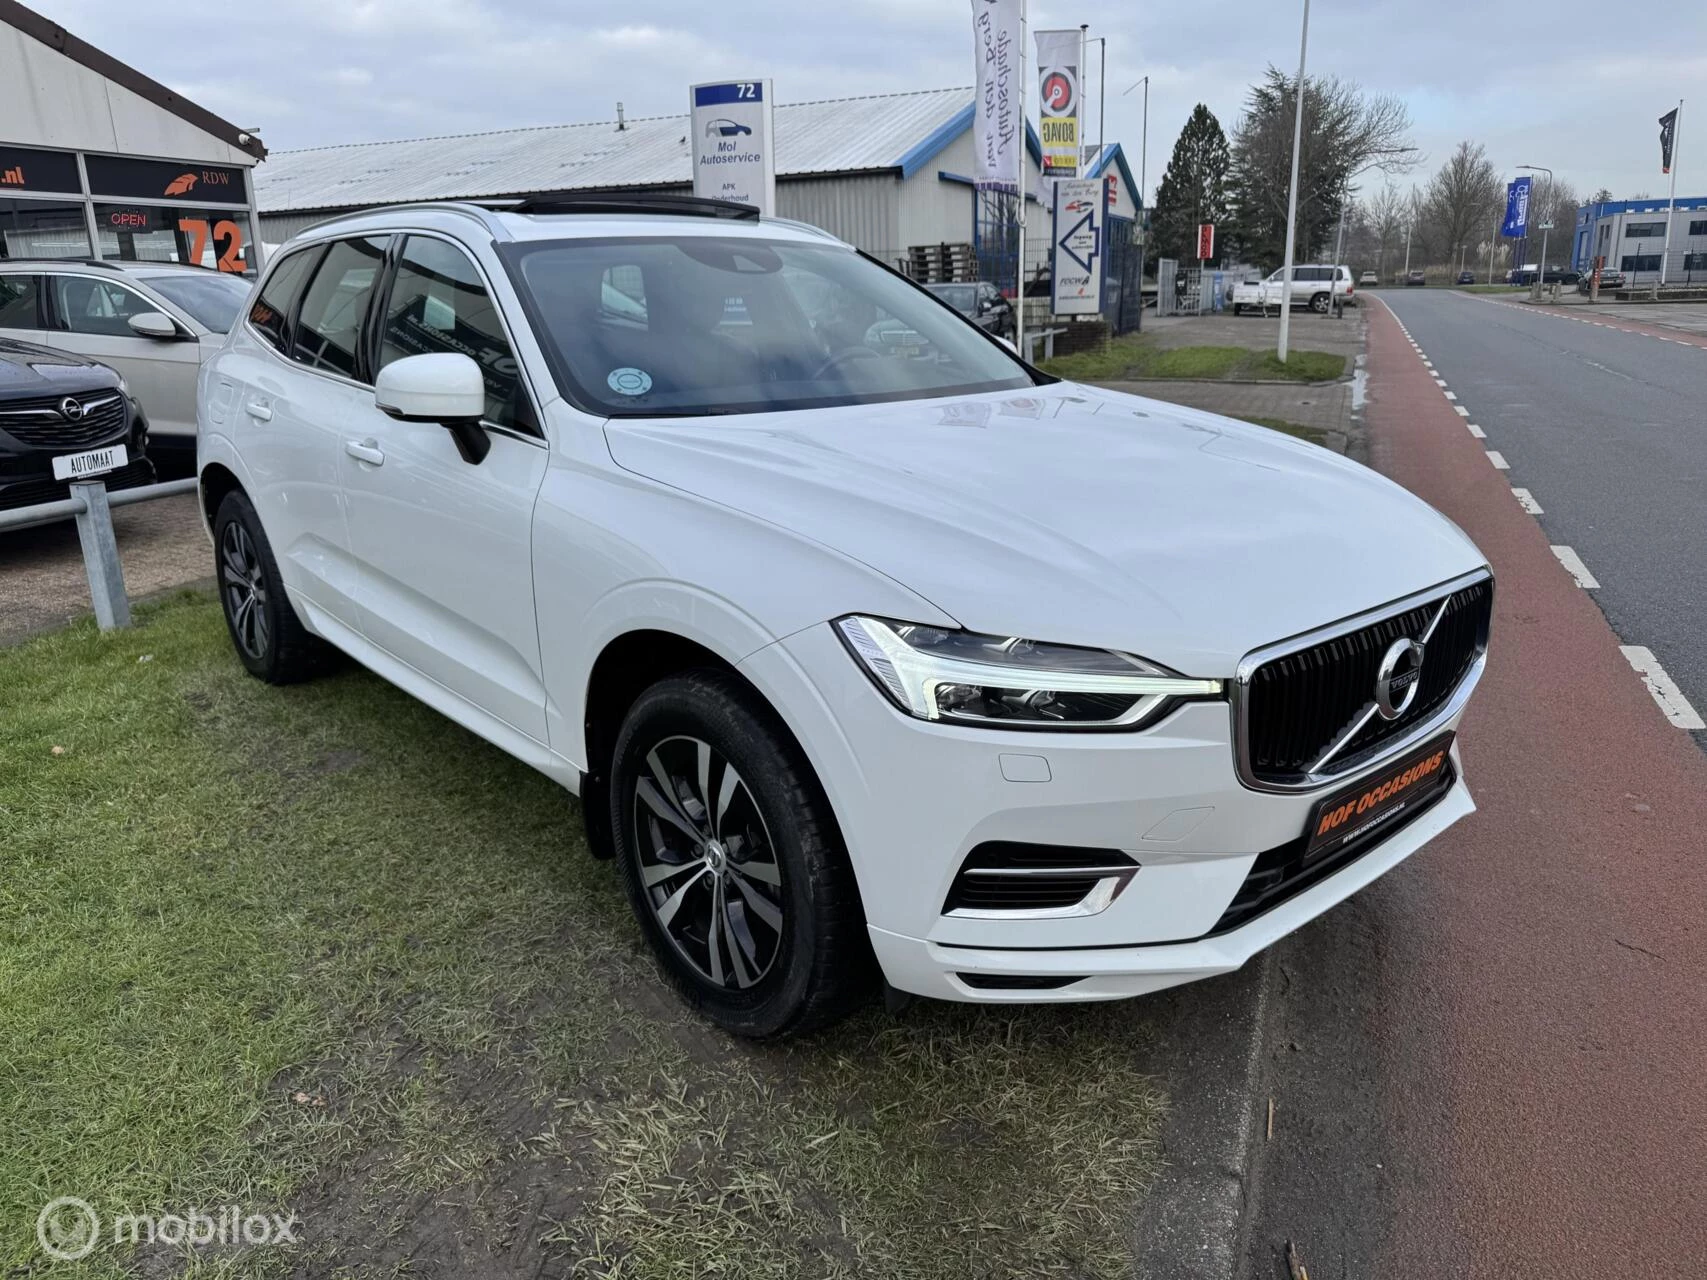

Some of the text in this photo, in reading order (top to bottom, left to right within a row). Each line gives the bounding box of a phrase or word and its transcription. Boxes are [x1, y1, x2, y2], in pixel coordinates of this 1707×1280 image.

[736, 83, 756, 98] 72
[717, 141, 737, 153] Mol
[699, 152, 761, 166] Autoservice
[202, 171, 230, 185] RDW
[722, 183, 736, 191] APK
[111, 212, 147, 227] OPEN
[178, 218, 248, 273] 72
[70, 450, 114, 474] AUTOMAAT
[1390, 671, 1418, 689] VOLVO
[1317, 750, 1445, 837] HOF OCCASIONS
